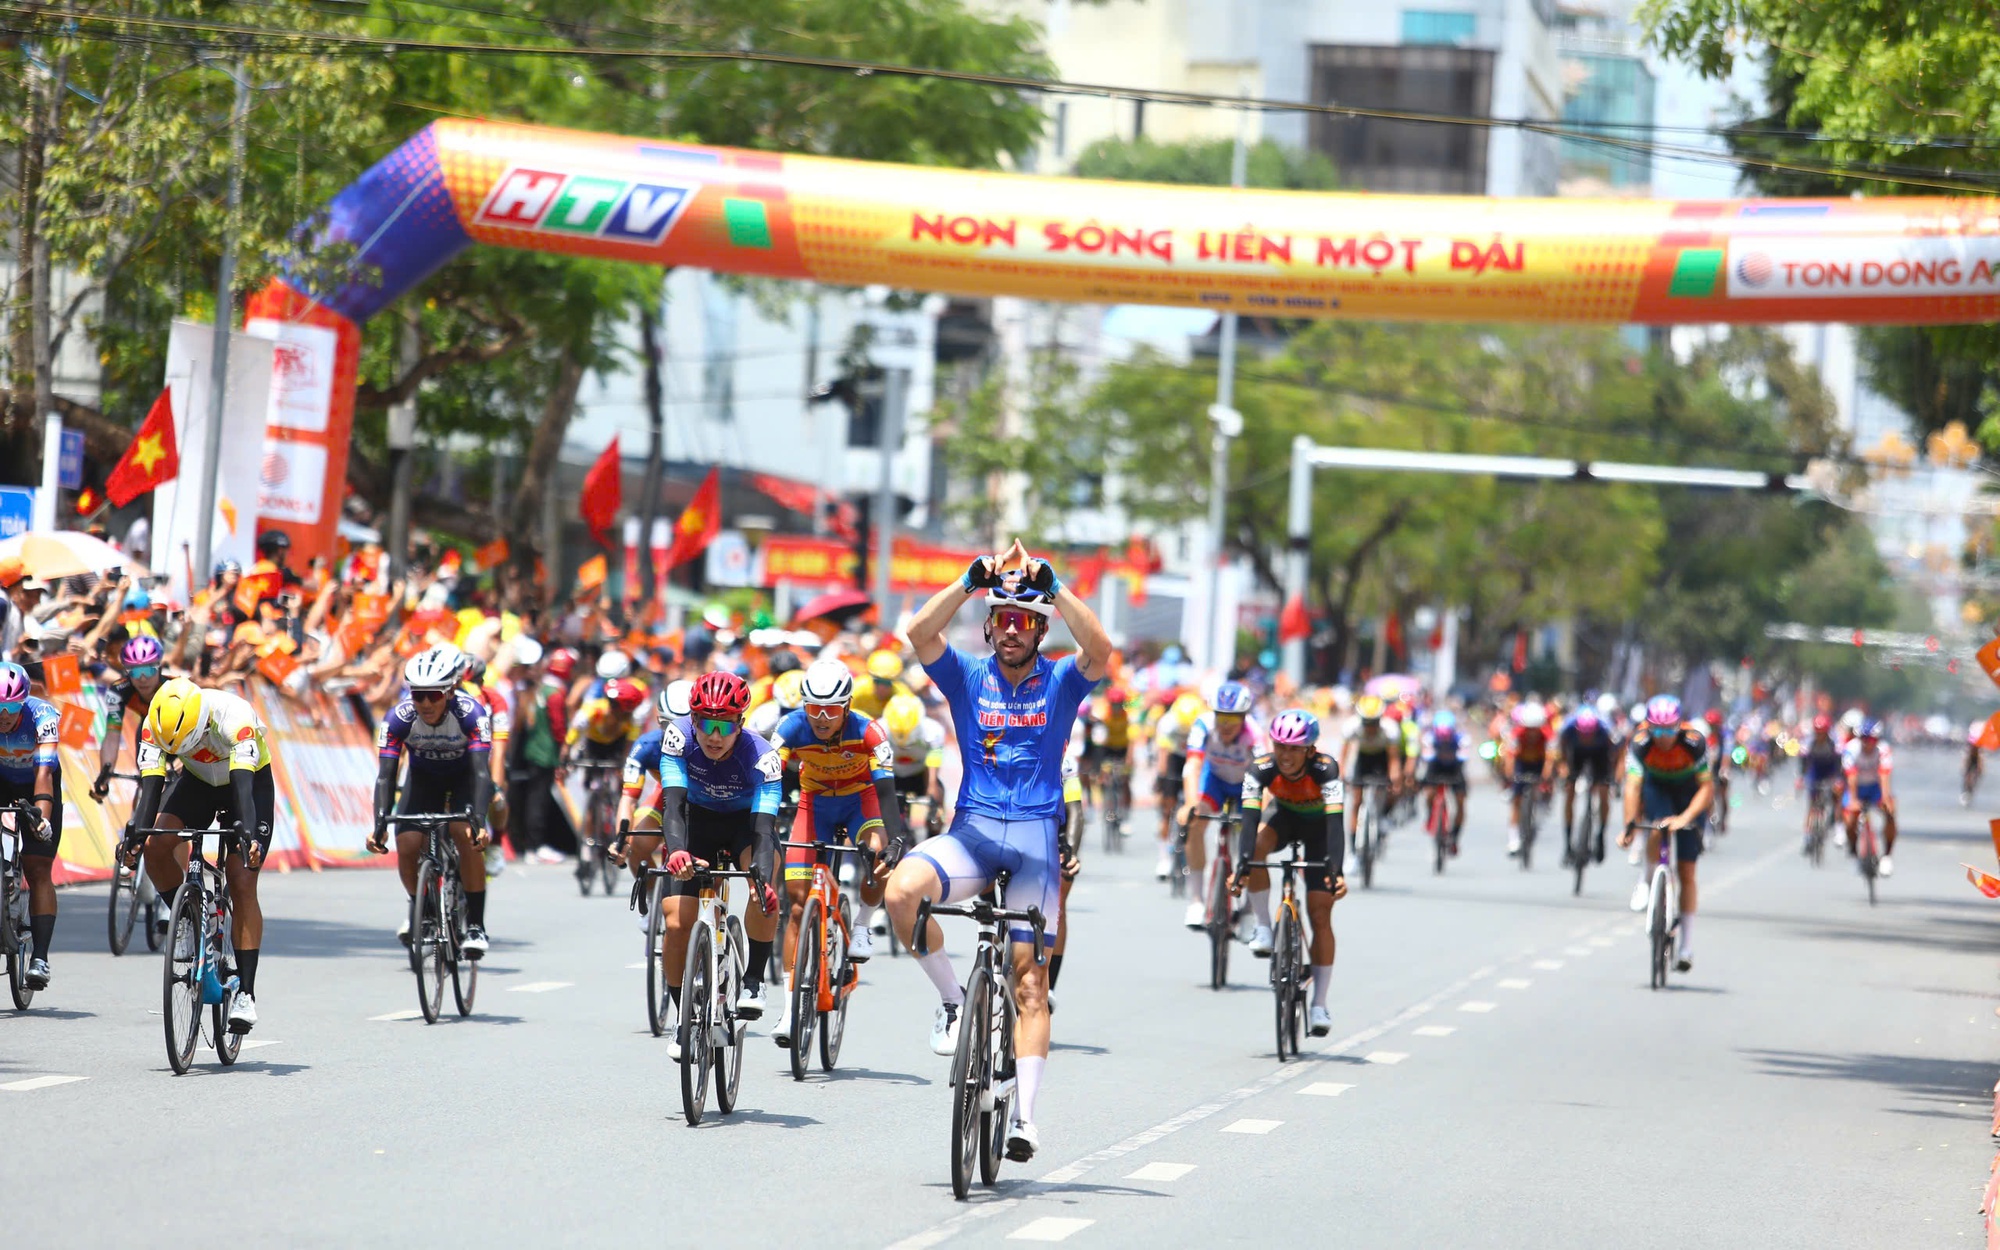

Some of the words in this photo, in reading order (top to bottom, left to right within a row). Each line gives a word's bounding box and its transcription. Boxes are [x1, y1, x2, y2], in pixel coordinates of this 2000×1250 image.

[488, 173, 684, 234] HTV
[911, 212, 1017, 248] NON
[1781, 262, 1850, 287] TON
[1862, 259, 1961, 286] DONG
[1969, 258, 1994, 286] A
[1008, 712, 1047, 727] GIANG
